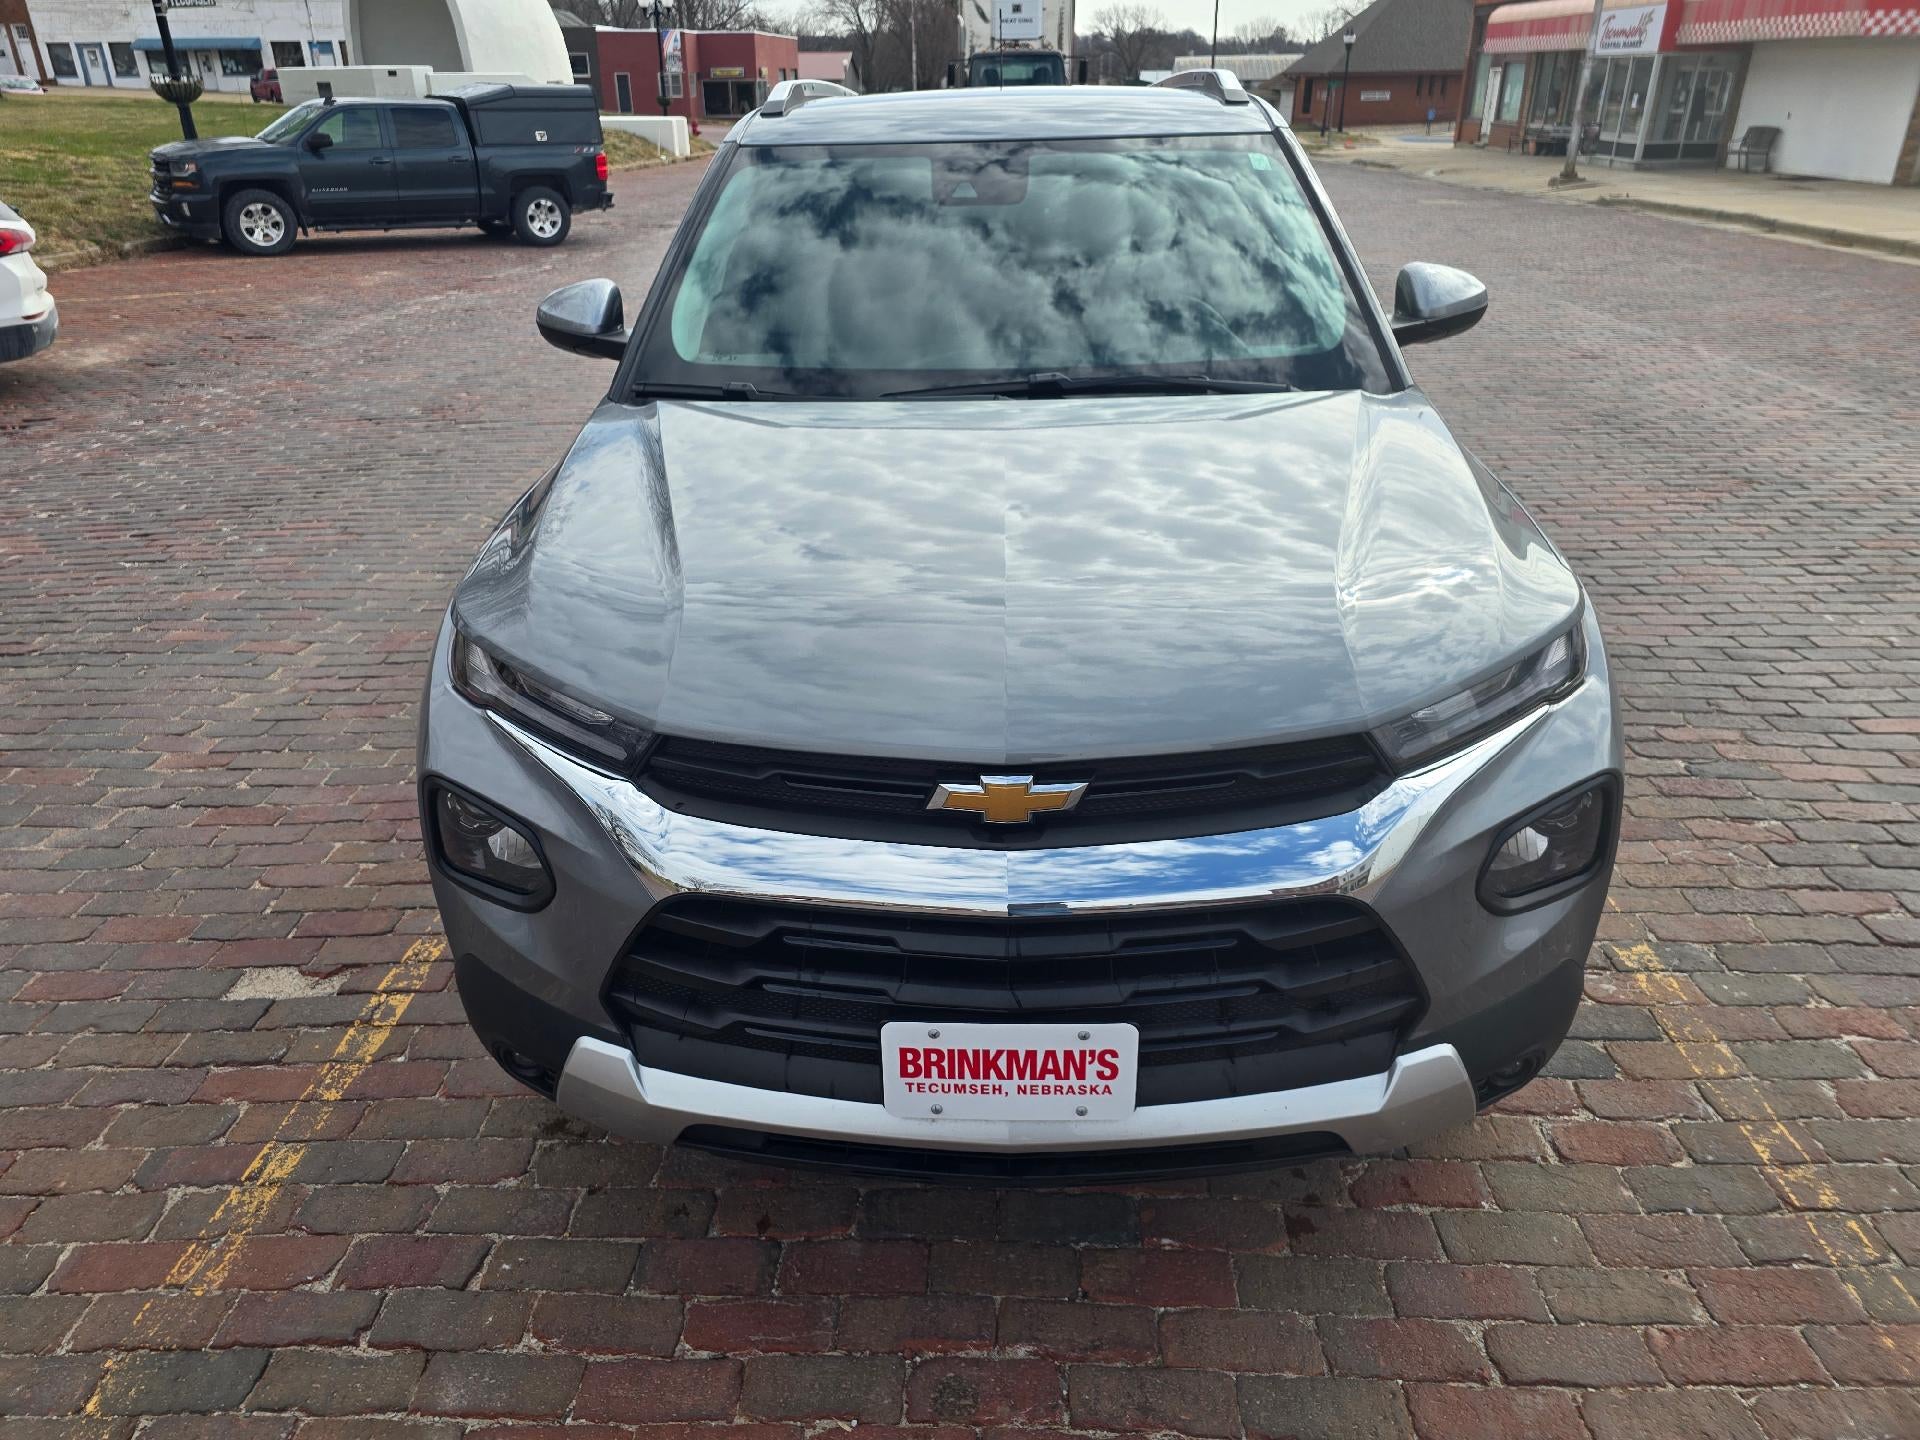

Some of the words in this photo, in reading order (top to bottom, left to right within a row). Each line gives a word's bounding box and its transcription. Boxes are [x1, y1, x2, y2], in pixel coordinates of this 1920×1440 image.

[898, 1047, 1120, 1080] BRINKMAN'S
[904, 1082, 1009, 1098] TECUMSEH,
[1017, 1084, 1113, 1096] NEBRASKA
